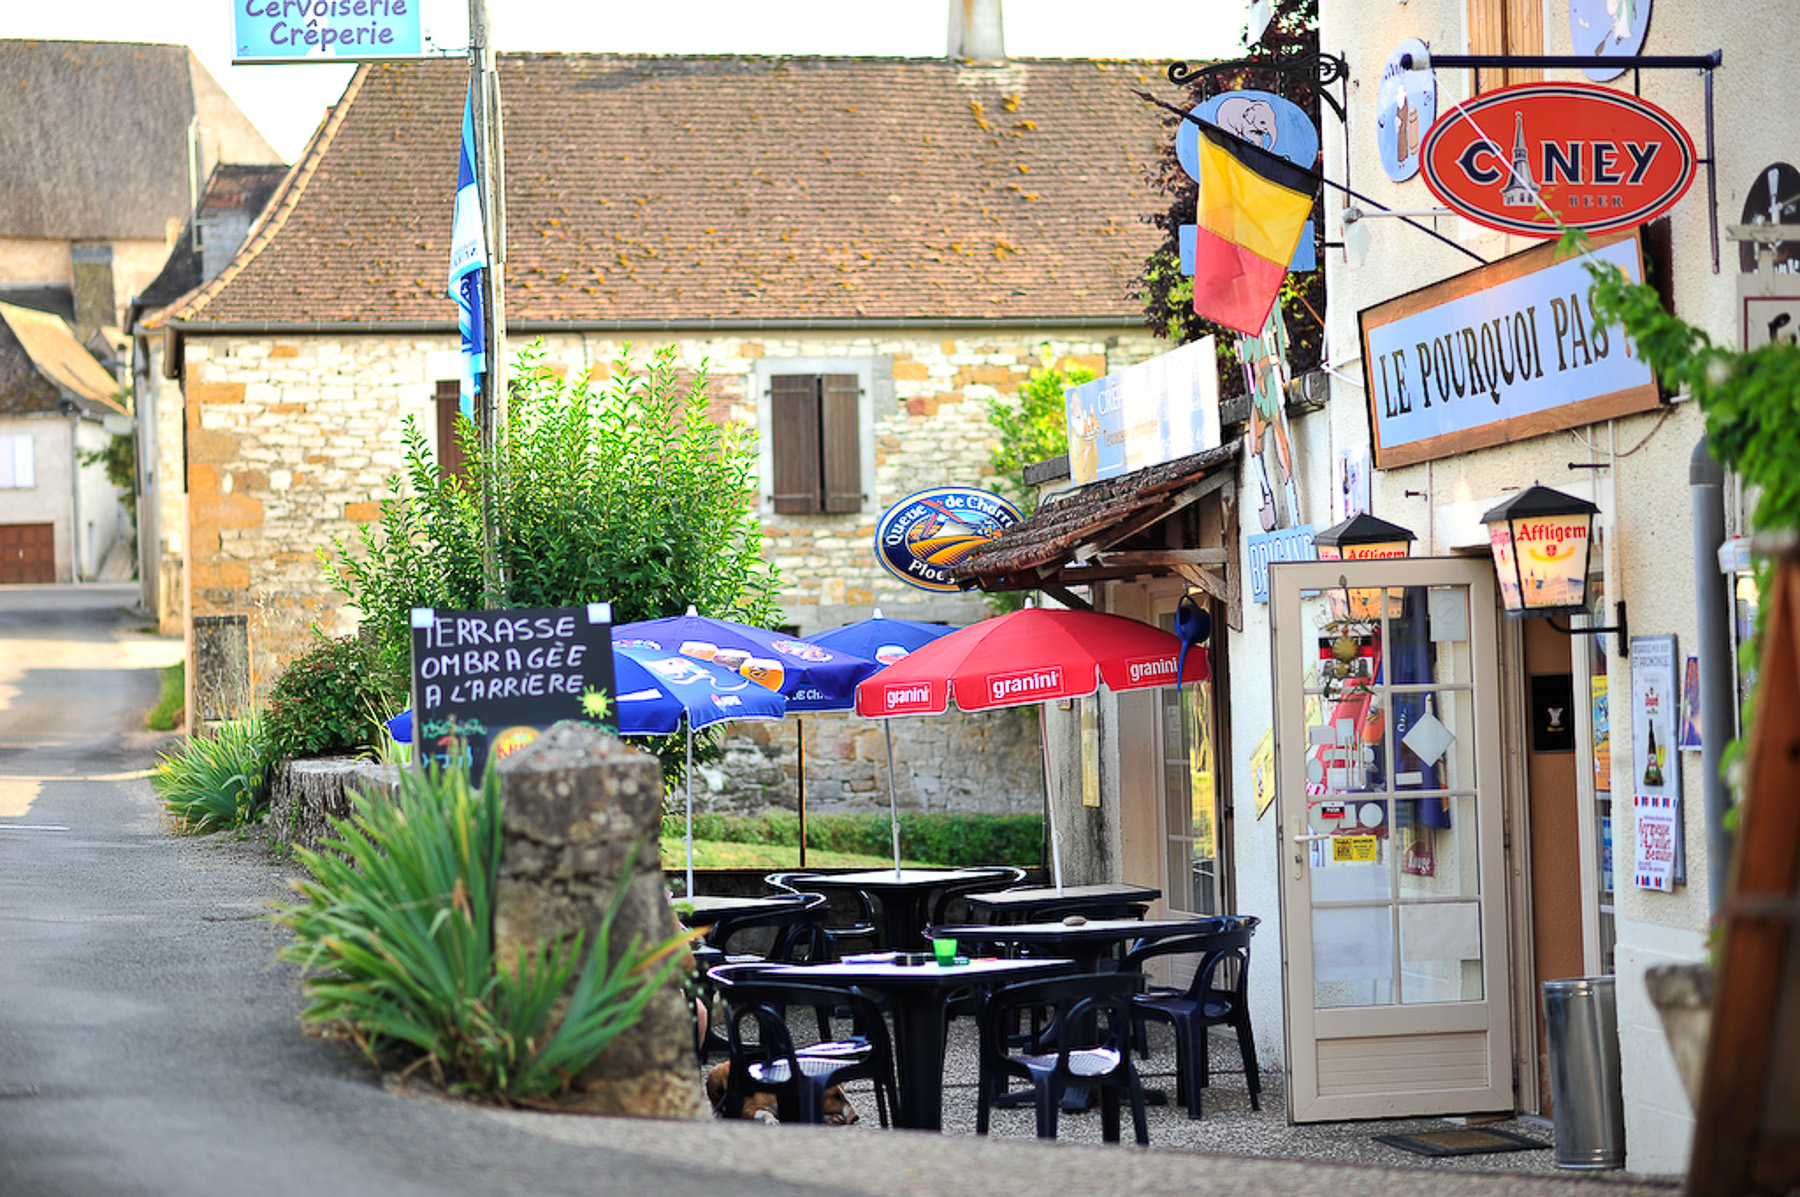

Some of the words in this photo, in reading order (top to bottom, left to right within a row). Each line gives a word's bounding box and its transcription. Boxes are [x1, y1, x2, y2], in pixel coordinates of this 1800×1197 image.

[245, 0, 408, 17] Cervoiserie
[270, 19, 395, 52] Crêperie
[1568, 195, 1624, 208] BEER
[1379, 349, 1412, 418] LE
[1416, 306, 1544, 405] POURQUOI
[886, 503, 928, 547] Queue
[945, 495, 964, 508] de
[1516, 523, 1587, 543] Affligem
[427, 616, 576, 649] TERRASSE
[1130, 657, 1178, 681] granini
[425, 684, 443, 710] A
[886, 685, 930, 709] granini
[992, 671, 1060, 699] granini
